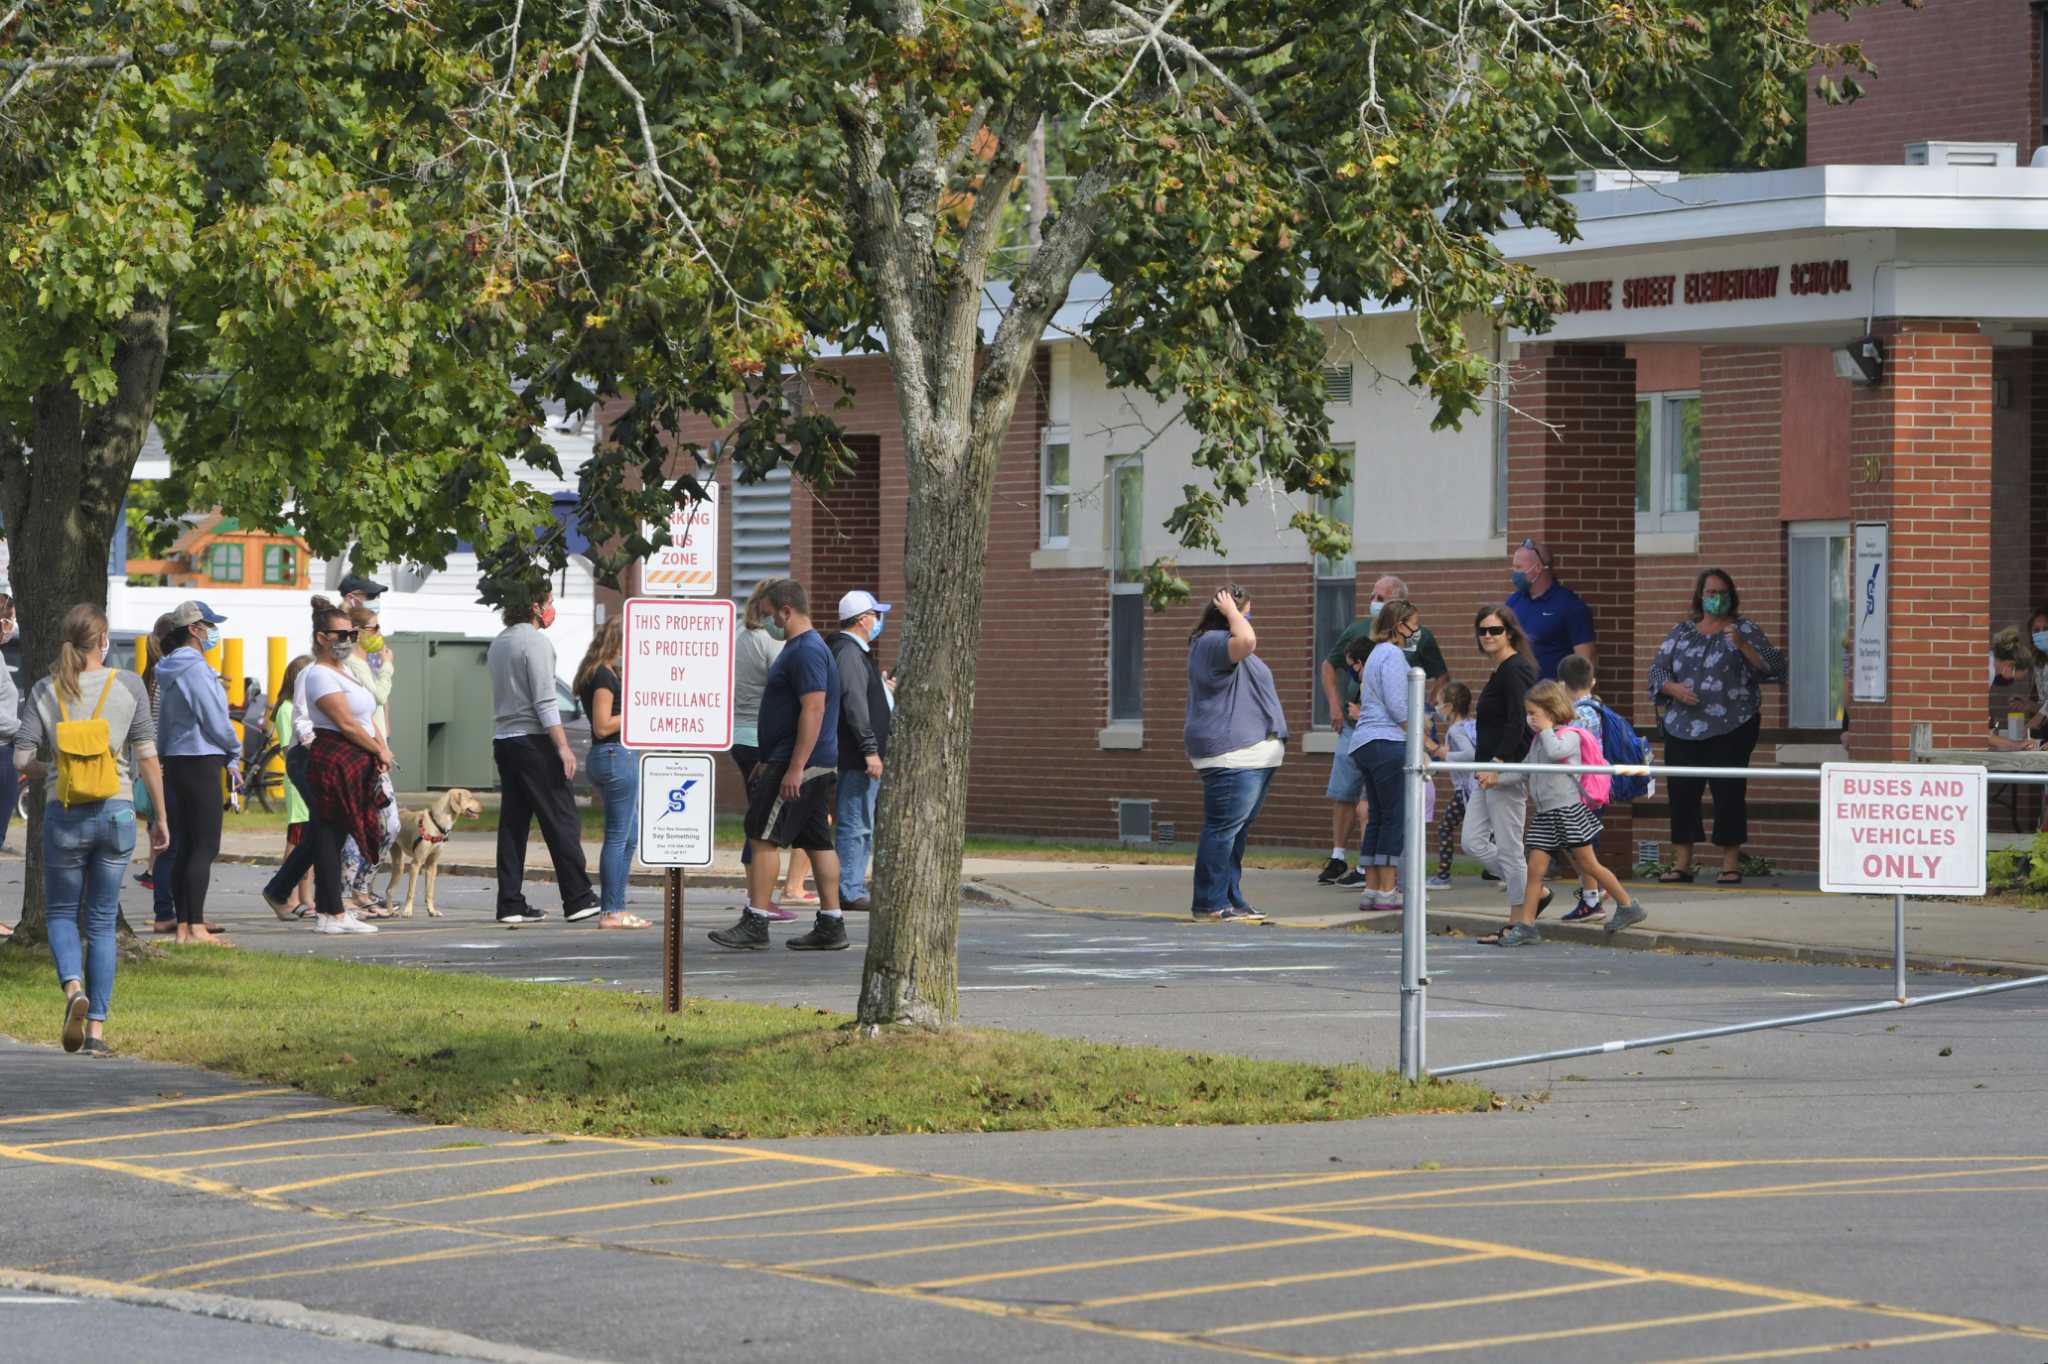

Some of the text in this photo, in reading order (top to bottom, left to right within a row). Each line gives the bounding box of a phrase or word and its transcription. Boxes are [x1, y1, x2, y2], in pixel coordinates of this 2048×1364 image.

[1622, 275, 1676, 309] STREET
[1684, 265, 1780, 305] ELEMENTARY
[1790, 259, 1852, 296] SCHOOL
[667, 512, 710, 525] RKING
[661, 552, 698, 565] ZONE
[635, 614, 725, 632] THIS PROPERTY
[639, 640, 720, 657] IS PROTECTED
[671, 666, 686, 681] BY
[634, 691, 721, 708] SURVEILLANCE
[649, 716, 705, 733] CAMERAS
[1843, 778, 1964, 797] BUSES AND
[1836, 803, 1968, 821] EMERGENCY
[1851, 827, 1956, 846] VEHICLES
[1862, 854, 1942, 879] ONLY
